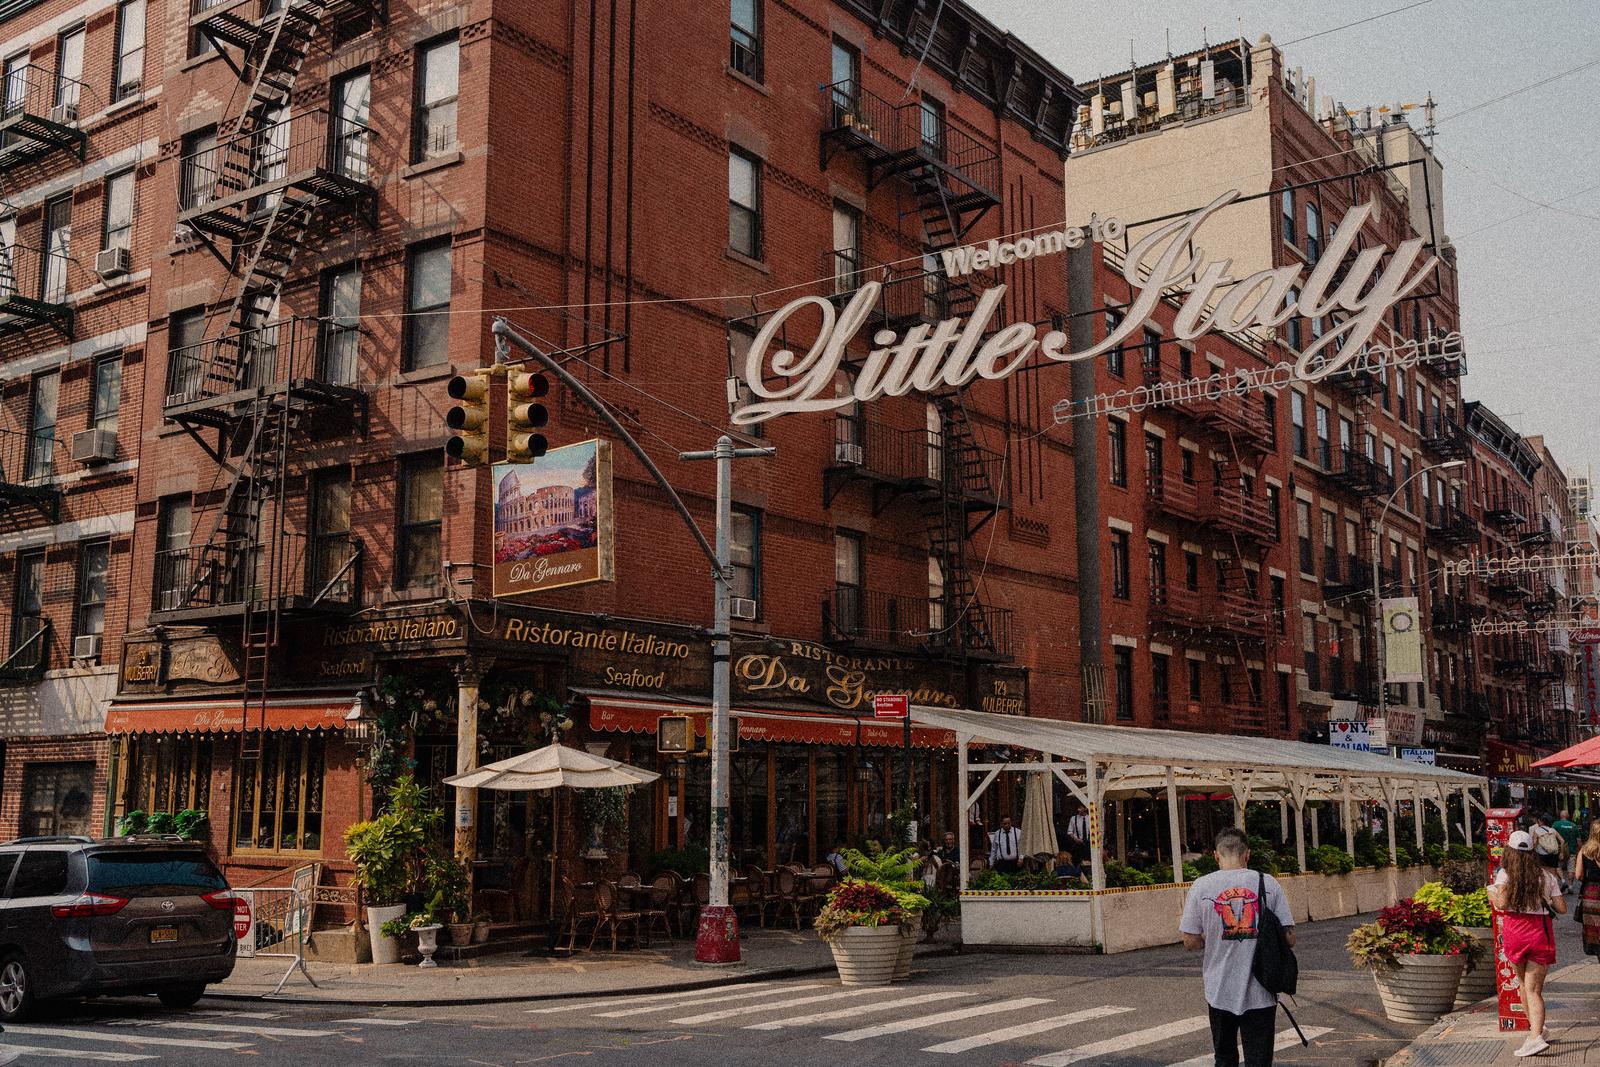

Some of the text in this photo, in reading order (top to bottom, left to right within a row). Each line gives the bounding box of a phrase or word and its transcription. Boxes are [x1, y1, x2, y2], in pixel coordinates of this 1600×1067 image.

[941, 216, 1126, 277] Welcome to
[731, 188, 1440, 427] Little Italy
[1086, 360, 1297, 419] incominciavo
[1346, 330, 1463, 377] volare
[509, 558, 583, 583] Da Gennaro
[325, 618, 457, 647] Ristorante Italiano
[504, 617, 690, 659] Ristorante Italiano
[320, 657, 366, 676] Seafood
[790, 641, 914, 672] RISTORANTE
[604, 667, 665, 689] Seafood
[736, 655, 812, 692] Da
[601, 710, 615, 721] Bar
[1331, 722, 1368, 733] I NY
[1497, 763, 1516, 773] NYC
[237, 905, 248, 914] NOT
